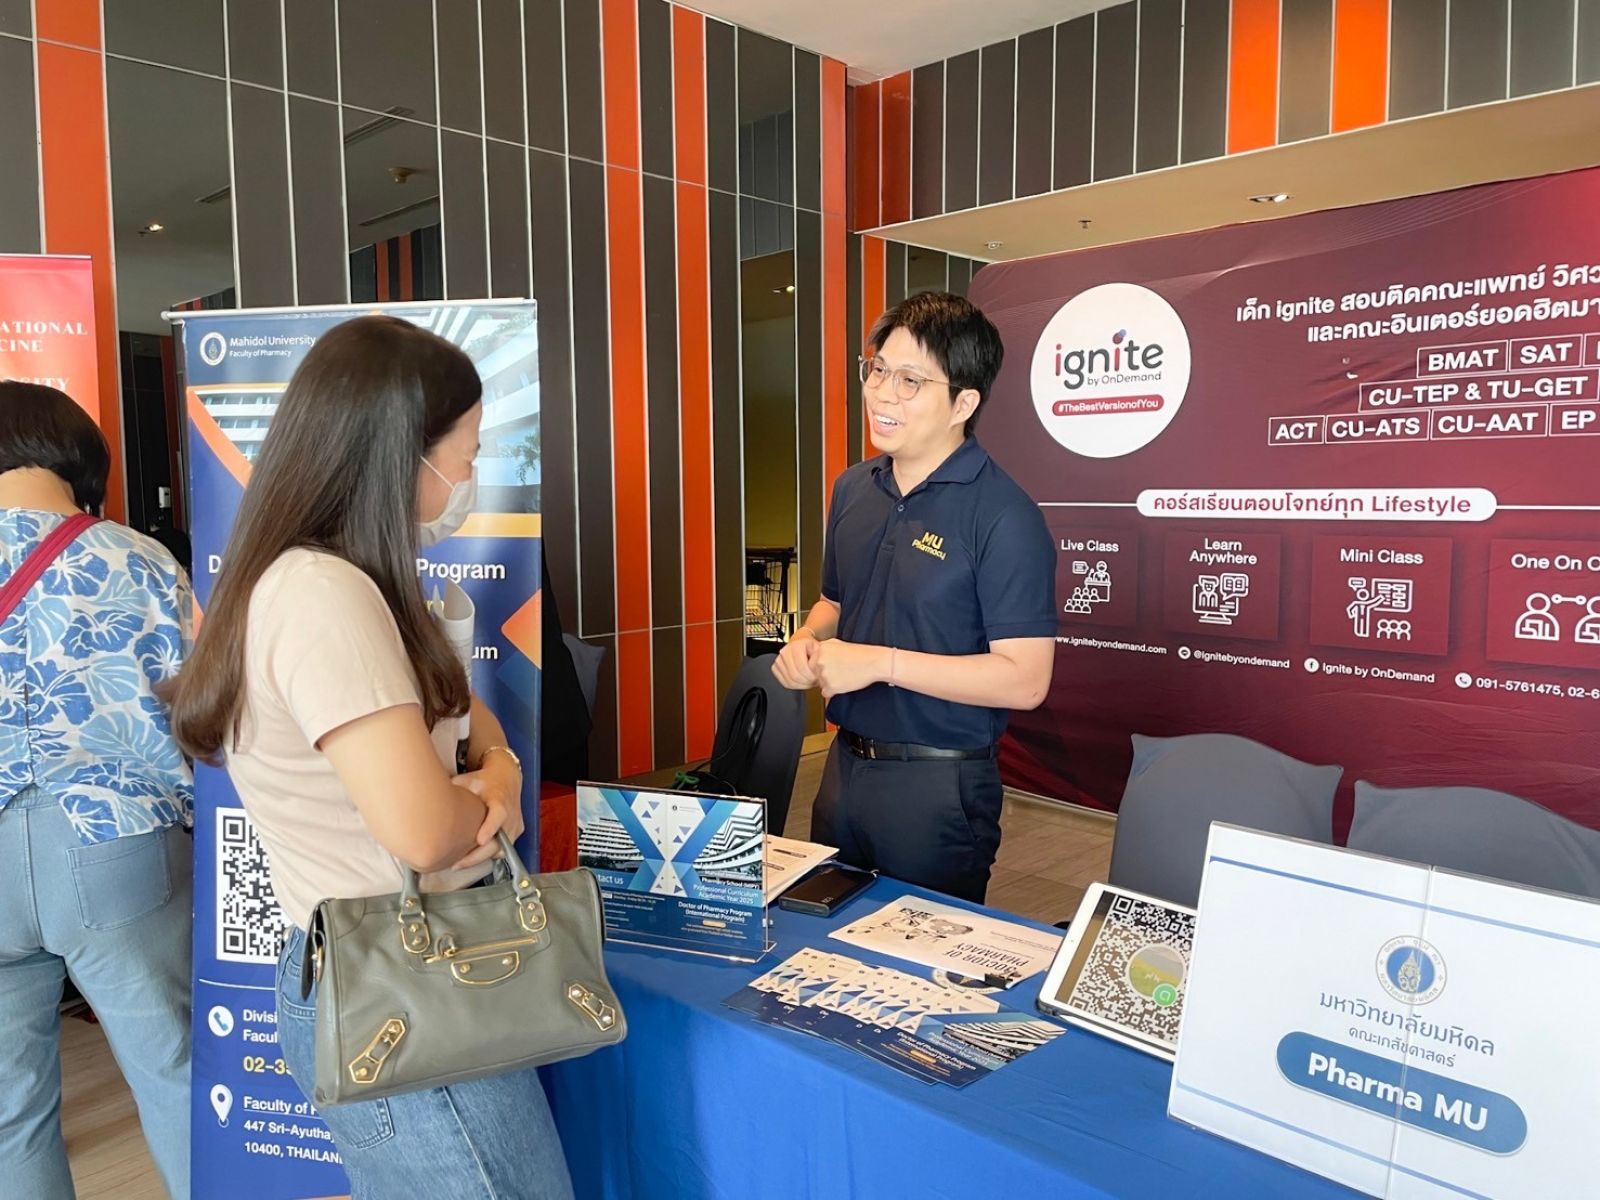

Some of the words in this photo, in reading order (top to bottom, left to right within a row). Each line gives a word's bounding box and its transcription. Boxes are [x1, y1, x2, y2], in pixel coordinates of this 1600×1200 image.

[1236, 297, 1271, 322] เด็ก
[1276, 297, 1335, 322] ignite
[1340, 264, 1547, 312] สอบติดคณะแพทย์
[229, 335, 267, 347] Mahidol
[268, 334, 316, 348] University
[229, 350, 252, 359] Faculty
[252, 349, 261, 357] of
[260, 348, 293, 358] Pharmacy
[1055, 329, 1164, 390] ignite
[1427, 348, 1499, 372] BMAT
[1519, 342, 1573, 364] SAT
[1087, 376, 1099, 387] by
[1101, 371, 1162, 385] OnDemand
[1464, 385, 1482, 401] &
[1058, 398, 1160, 415] #TheBestVersionofYou
[1275, 422, 1318, 441] ACT
[1561, 410, 1597, 430] EP
[1371, 495, 1472, 515] Lifestyle
[911, 538, 947, 561] Pharmacy
[921, 531, 945, 550] MU
[1060, 539, 1085, 551] Live
[1086, 540, 1120, 552] Class
[1204, 538, 1242, 551] Learn
[1188, 550, 1258, 566] Anywhere
[1340, 548, 1373, 563] Mini
[1377, 550, 1424, 565] Class
[1511, 554, 1550, 570] One
[1554, 555, 1582, 570] On
[415, 558, 506, 585] Program
[1354, 666, 1369, 678] by
[1370, 667, 1435, 683] OnDemand
[1319, 992, 1496, 1057] มหาวิทยาลัยมหิดล
[1308, 1051, 1423, 1112] Pharma
[1432, 1092, 1489, 1132] MU
[243, 1095, 291, 1115] Faculty
[295, 1104, 309, 1115] of
[243, 1119, 266, 1134] 447
[244, 1141, 285, 1158] 10400,
[286, 1146, 343, 1165] THAILAN
